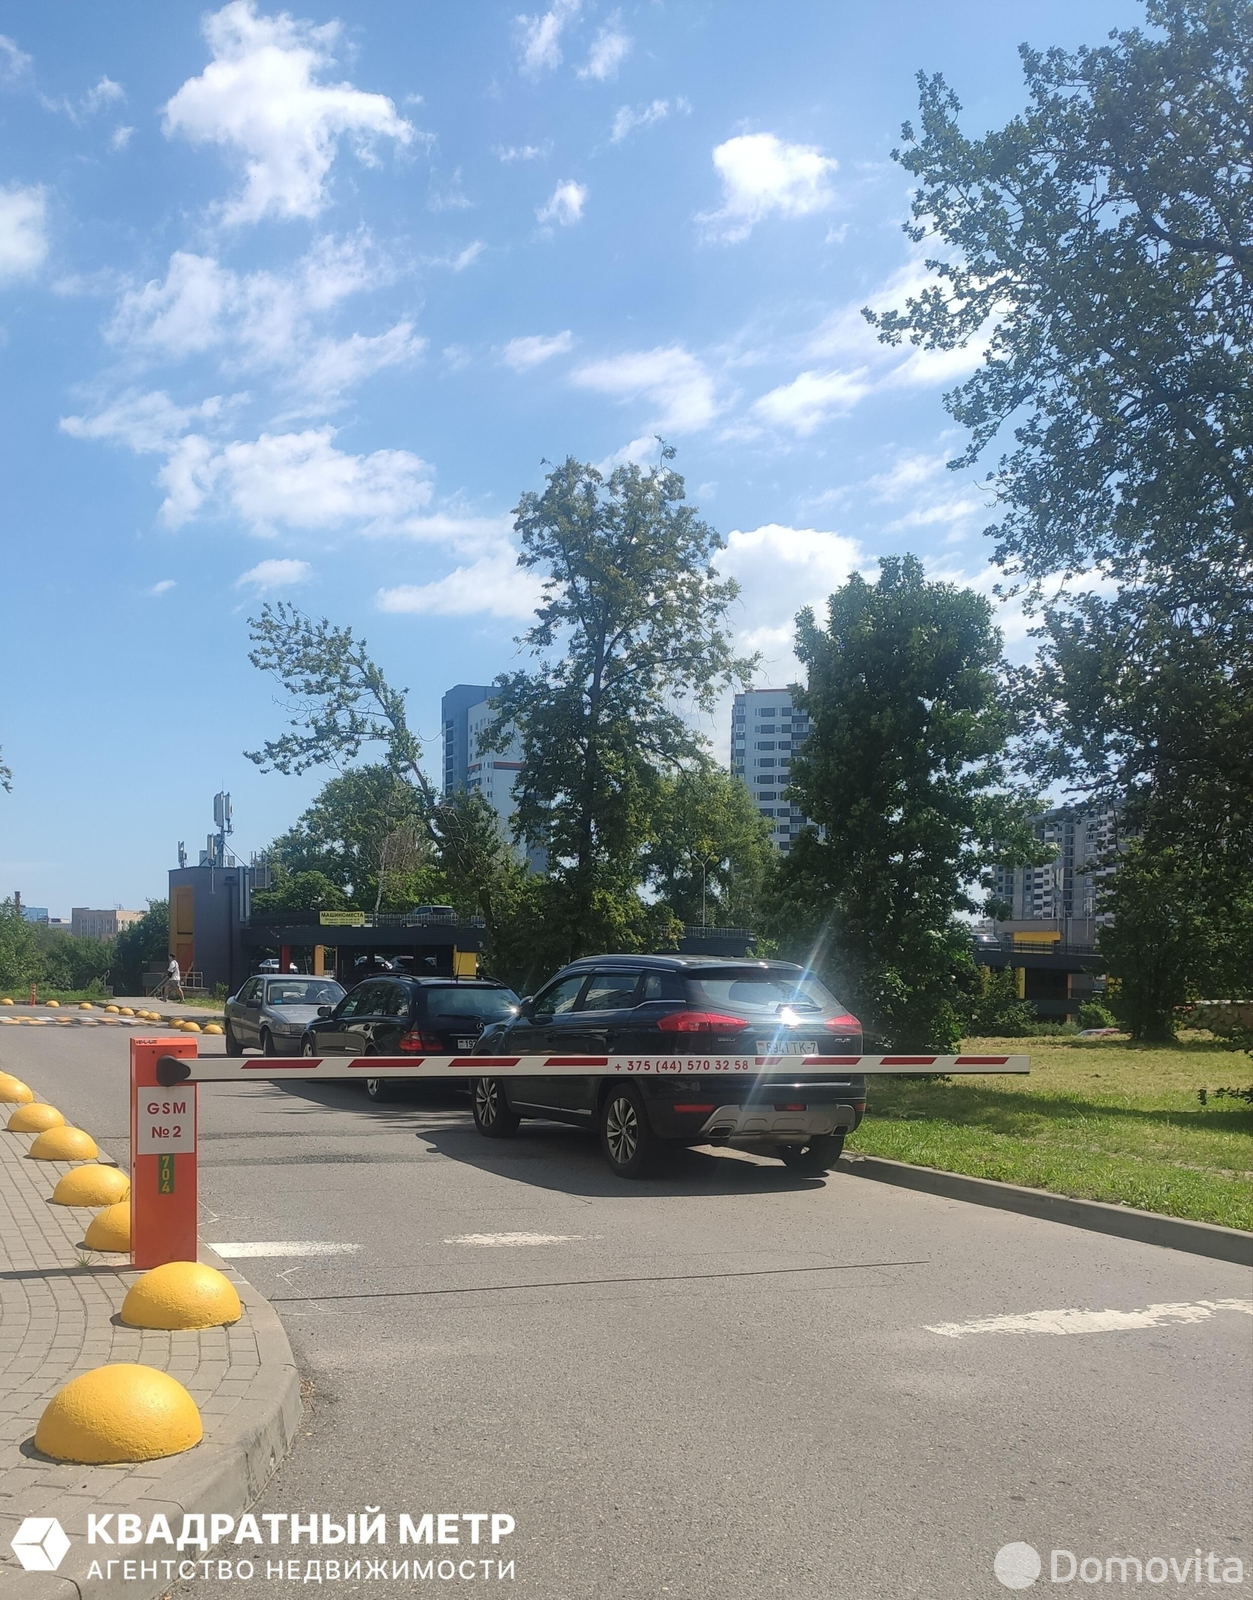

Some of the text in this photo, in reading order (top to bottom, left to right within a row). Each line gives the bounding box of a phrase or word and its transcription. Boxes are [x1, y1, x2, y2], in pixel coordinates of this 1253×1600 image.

[614, 1060, 749, 1073] + 375 (44) 570 32 58
[147, 1102, 186, 1115] GSM
